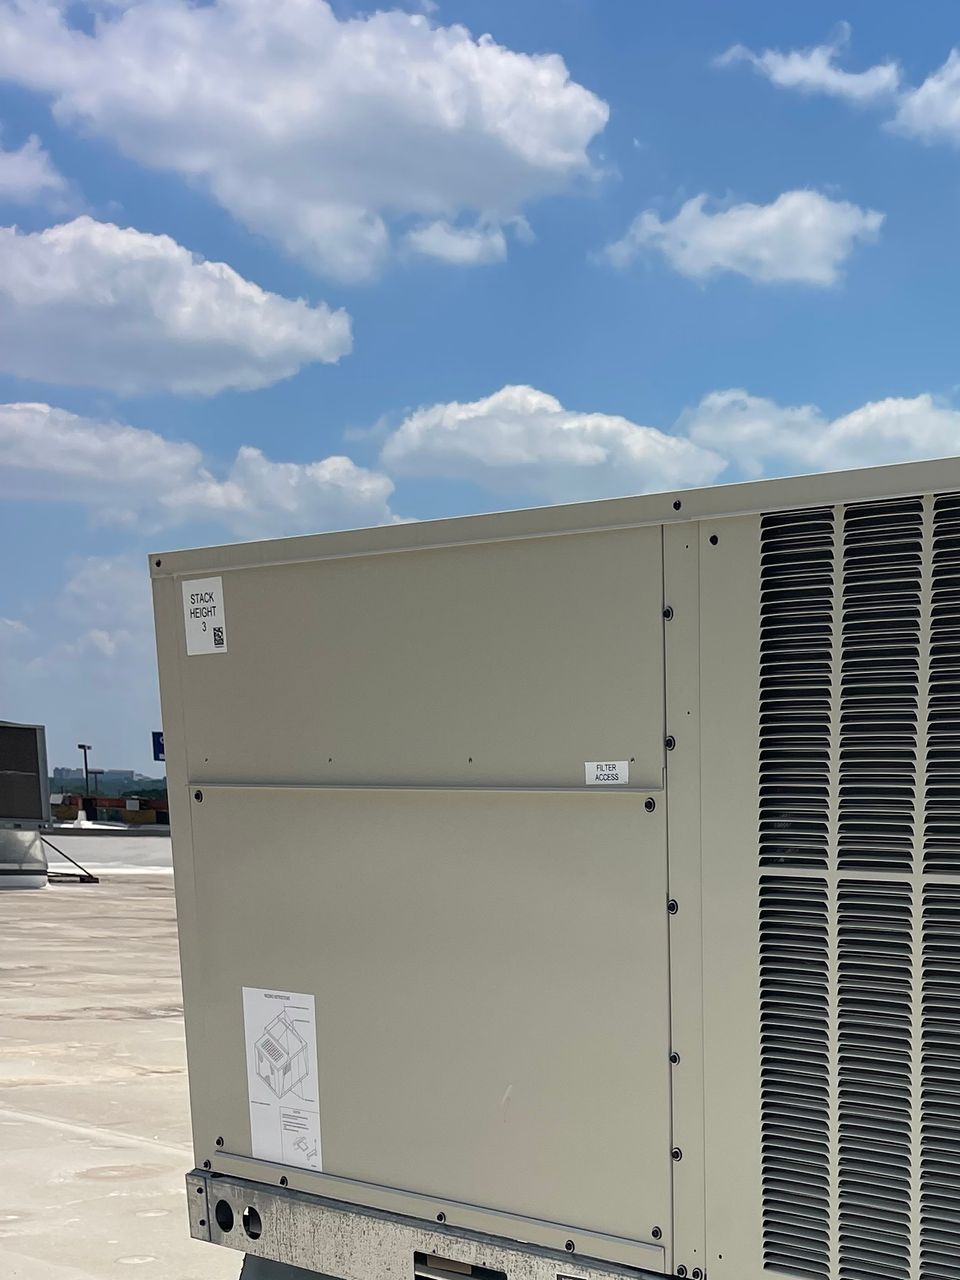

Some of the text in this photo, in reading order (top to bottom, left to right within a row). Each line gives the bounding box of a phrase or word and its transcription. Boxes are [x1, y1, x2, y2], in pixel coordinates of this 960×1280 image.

[190, 592, 215, 605] STACK
[189, 605, 217, 619] HEIGHT
[201, 621, 207, 632] 3
[596, 763, 617, 772] FILTER
[595, 773, 619, 782] ACCESS
